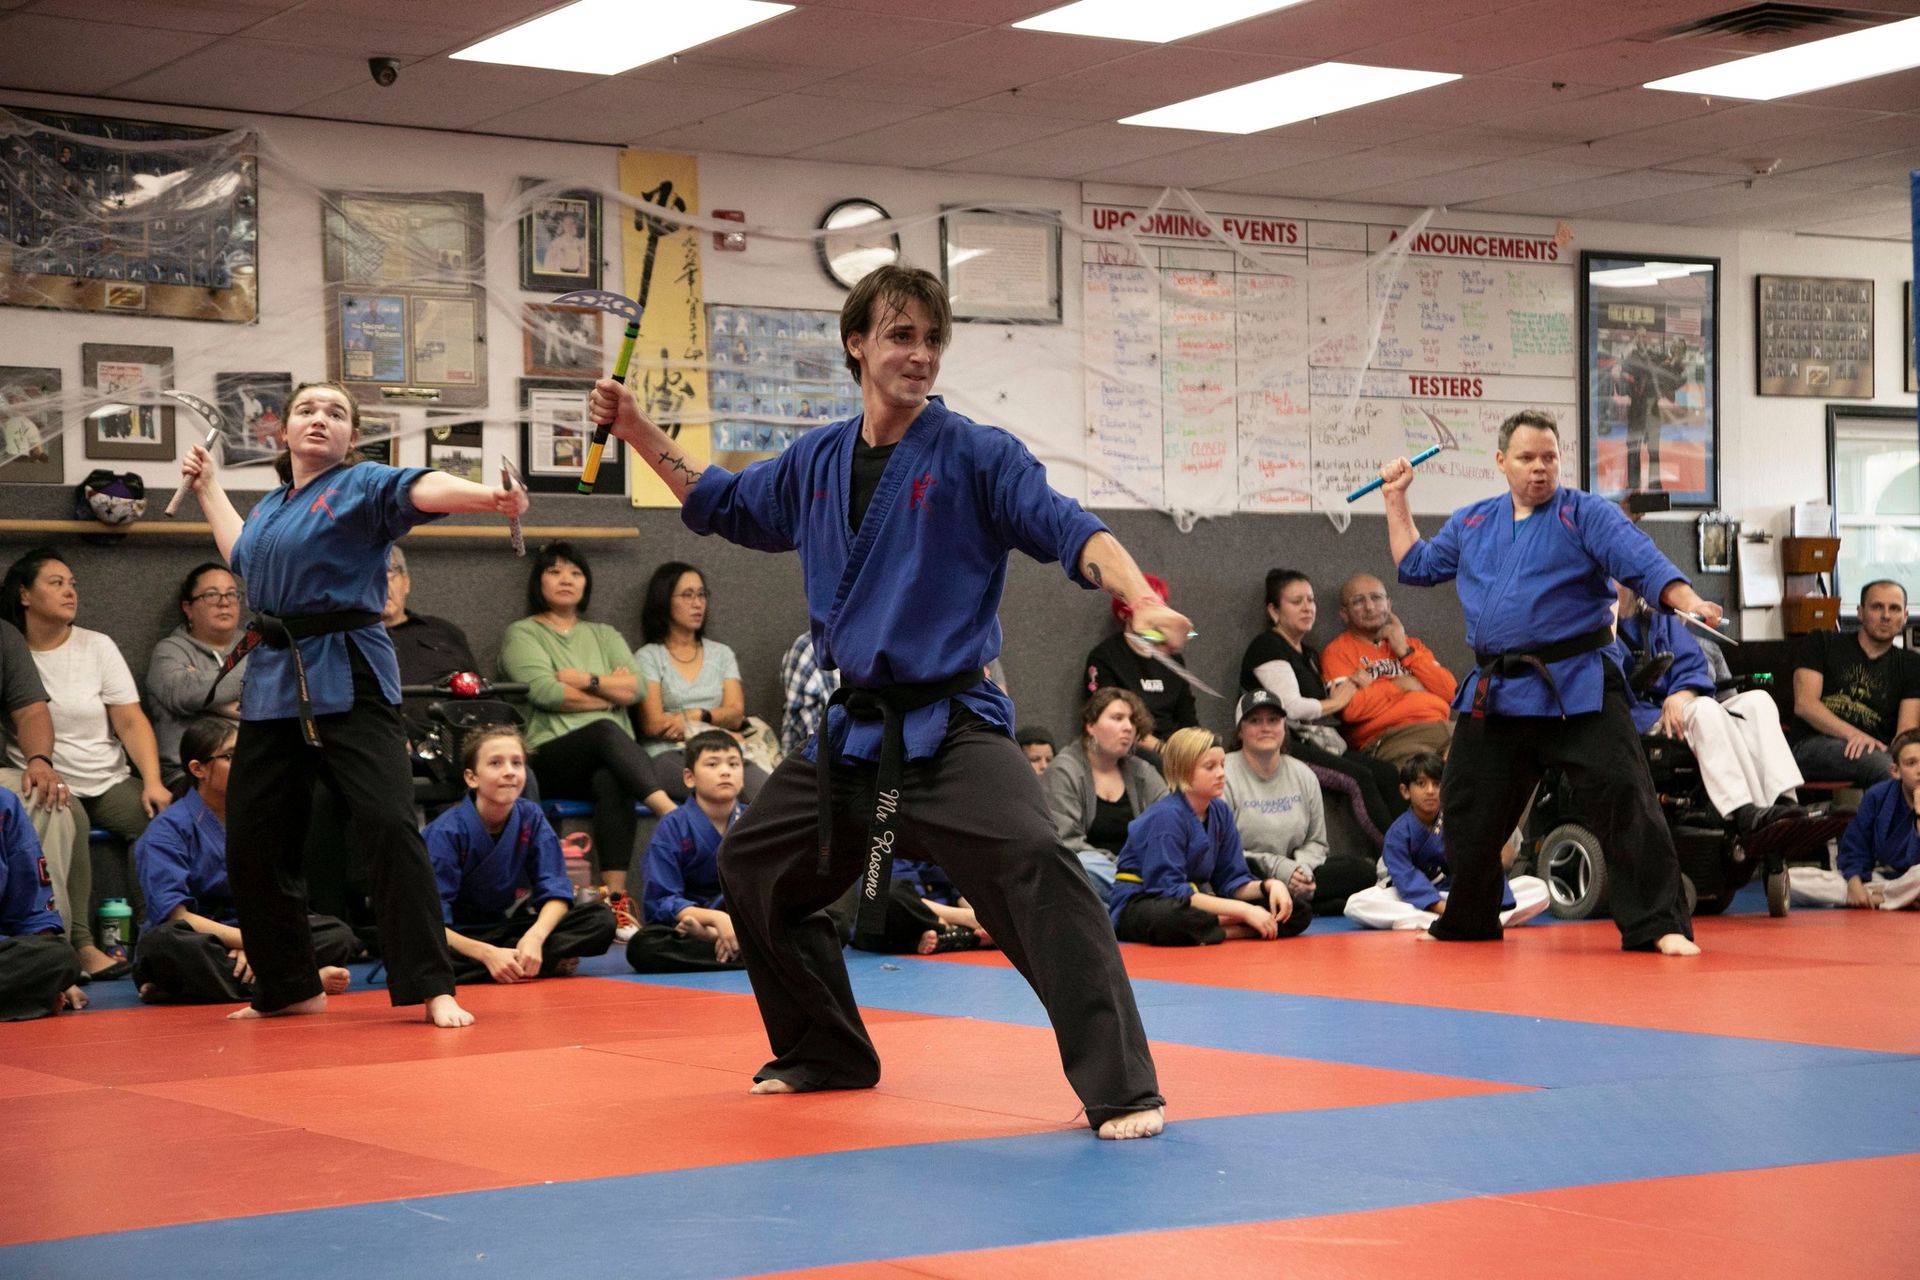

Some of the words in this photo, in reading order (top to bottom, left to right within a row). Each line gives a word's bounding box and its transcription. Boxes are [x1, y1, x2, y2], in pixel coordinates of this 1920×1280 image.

[1223, 218, 1298, 244] EVENTS
[1409, 375, 1483, 398] TESTERS
[876, 789, 900, 823] Mr
